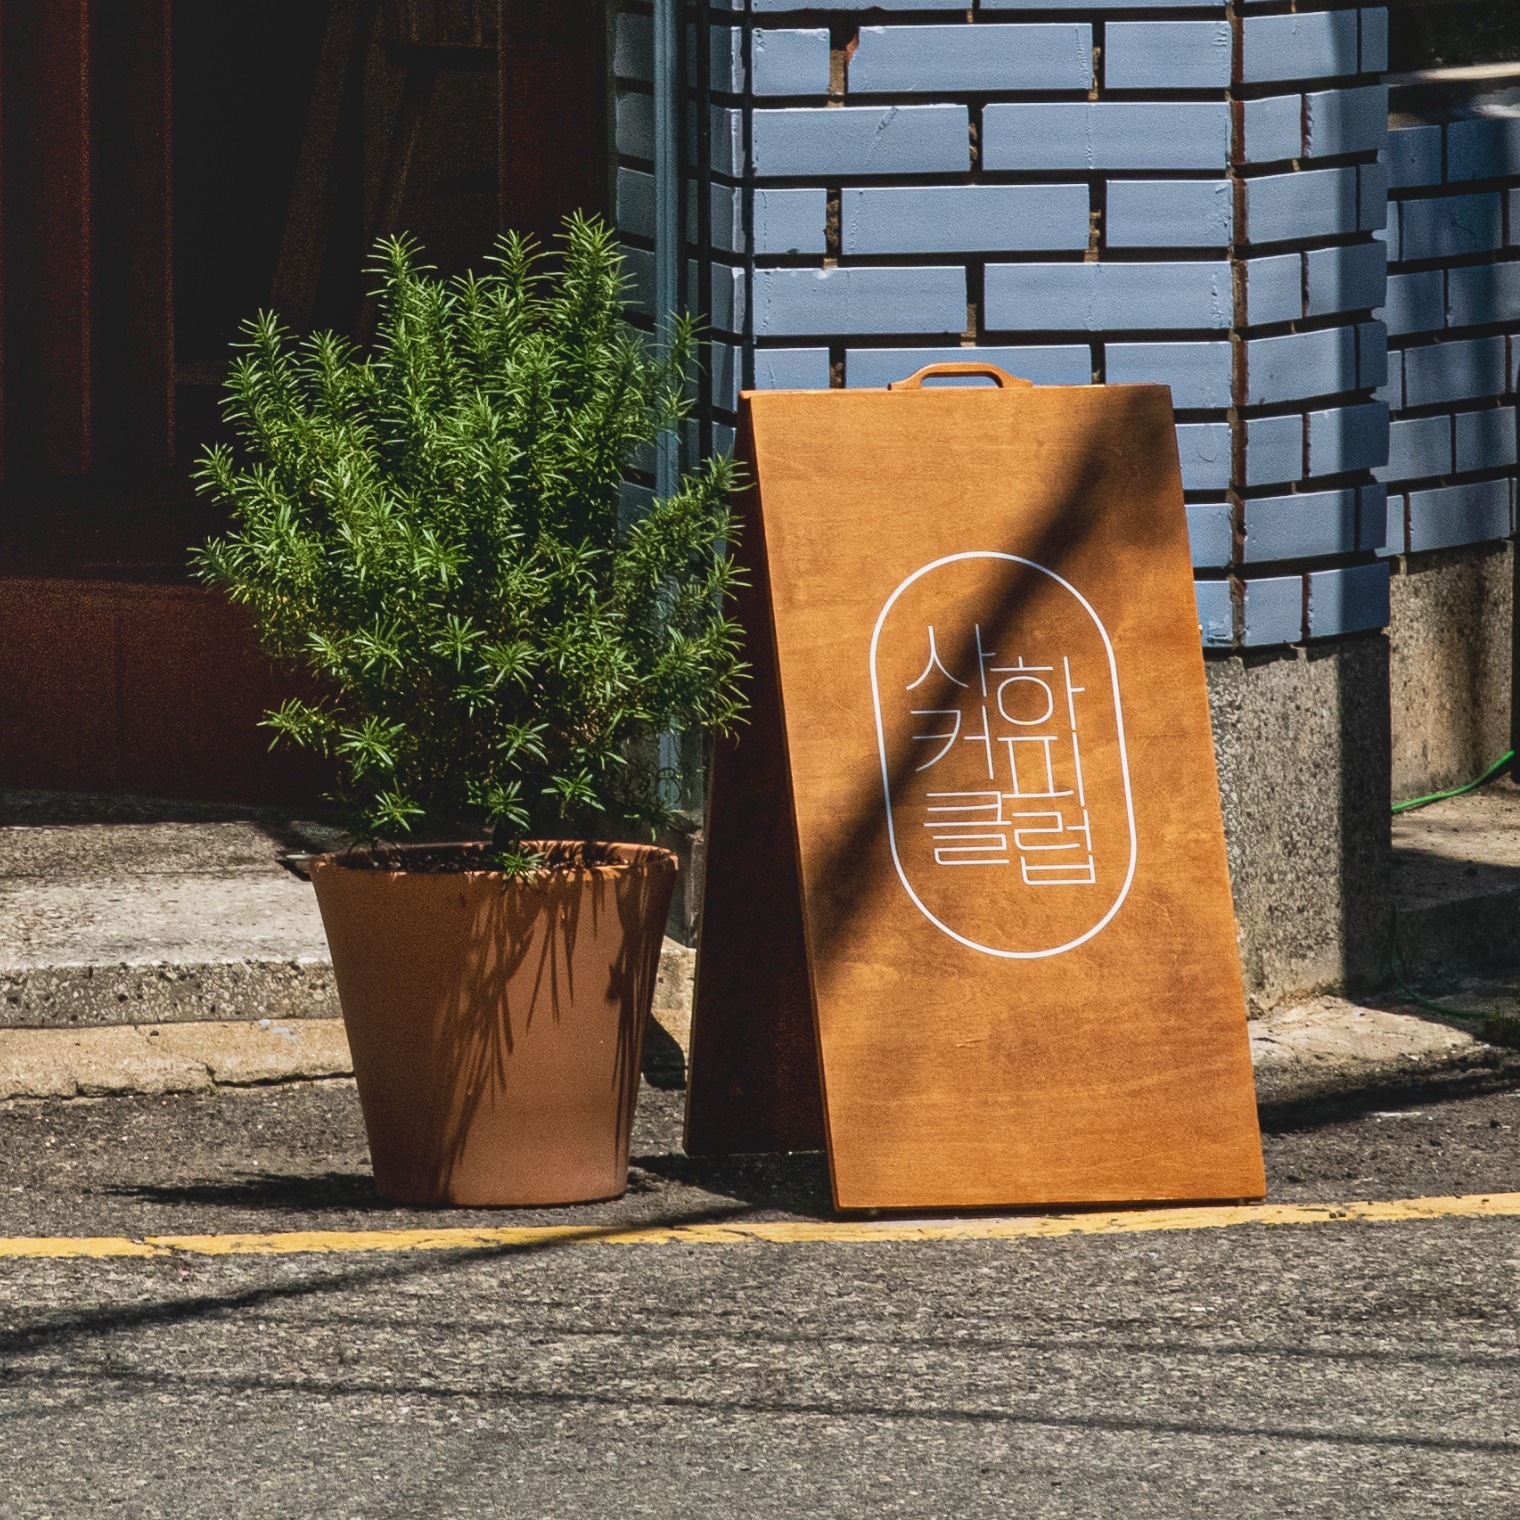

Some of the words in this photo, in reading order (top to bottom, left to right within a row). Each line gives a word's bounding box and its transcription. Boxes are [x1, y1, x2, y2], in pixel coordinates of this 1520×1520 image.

[906, 623, 1086, 730] 사하
[910, 705, 1085, 807] 커피
[923, 790, 1096, 885] 클럽
